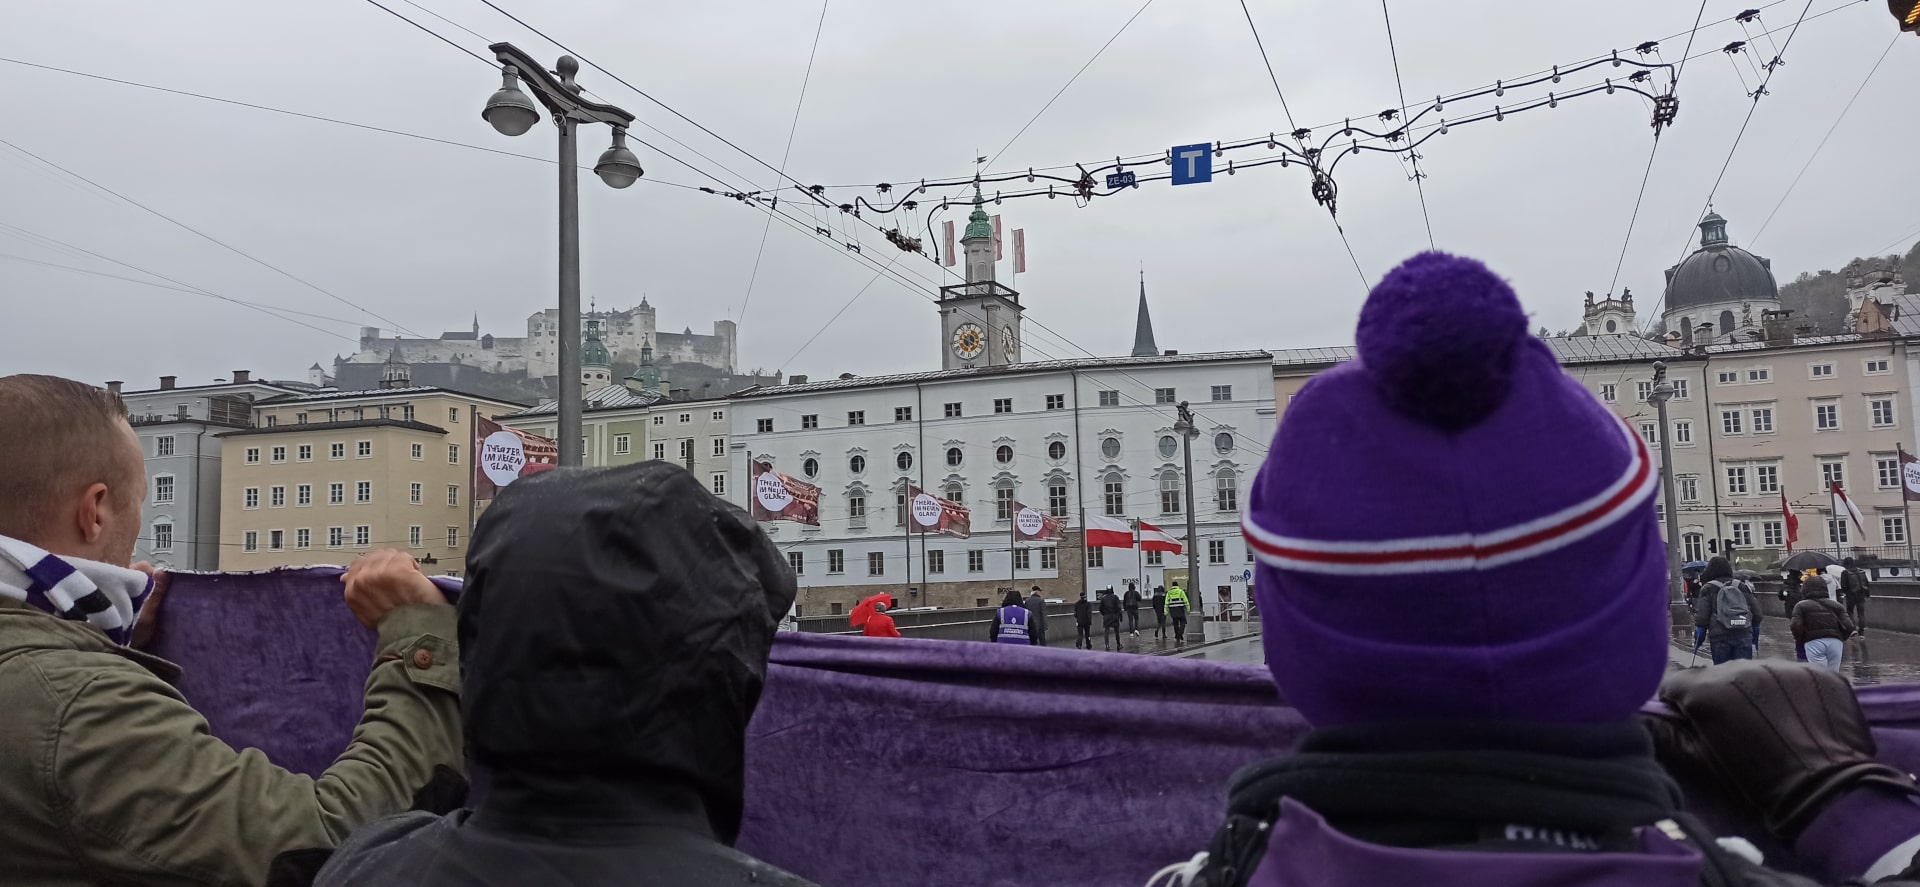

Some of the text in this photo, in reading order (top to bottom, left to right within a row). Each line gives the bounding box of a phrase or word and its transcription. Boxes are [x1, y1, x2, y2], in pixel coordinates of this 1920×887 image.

[1180, 150, 1203, 178] T
[1107, 174, 1134, 186] ZE-03
[486, 444, 521, 456] THEATER
